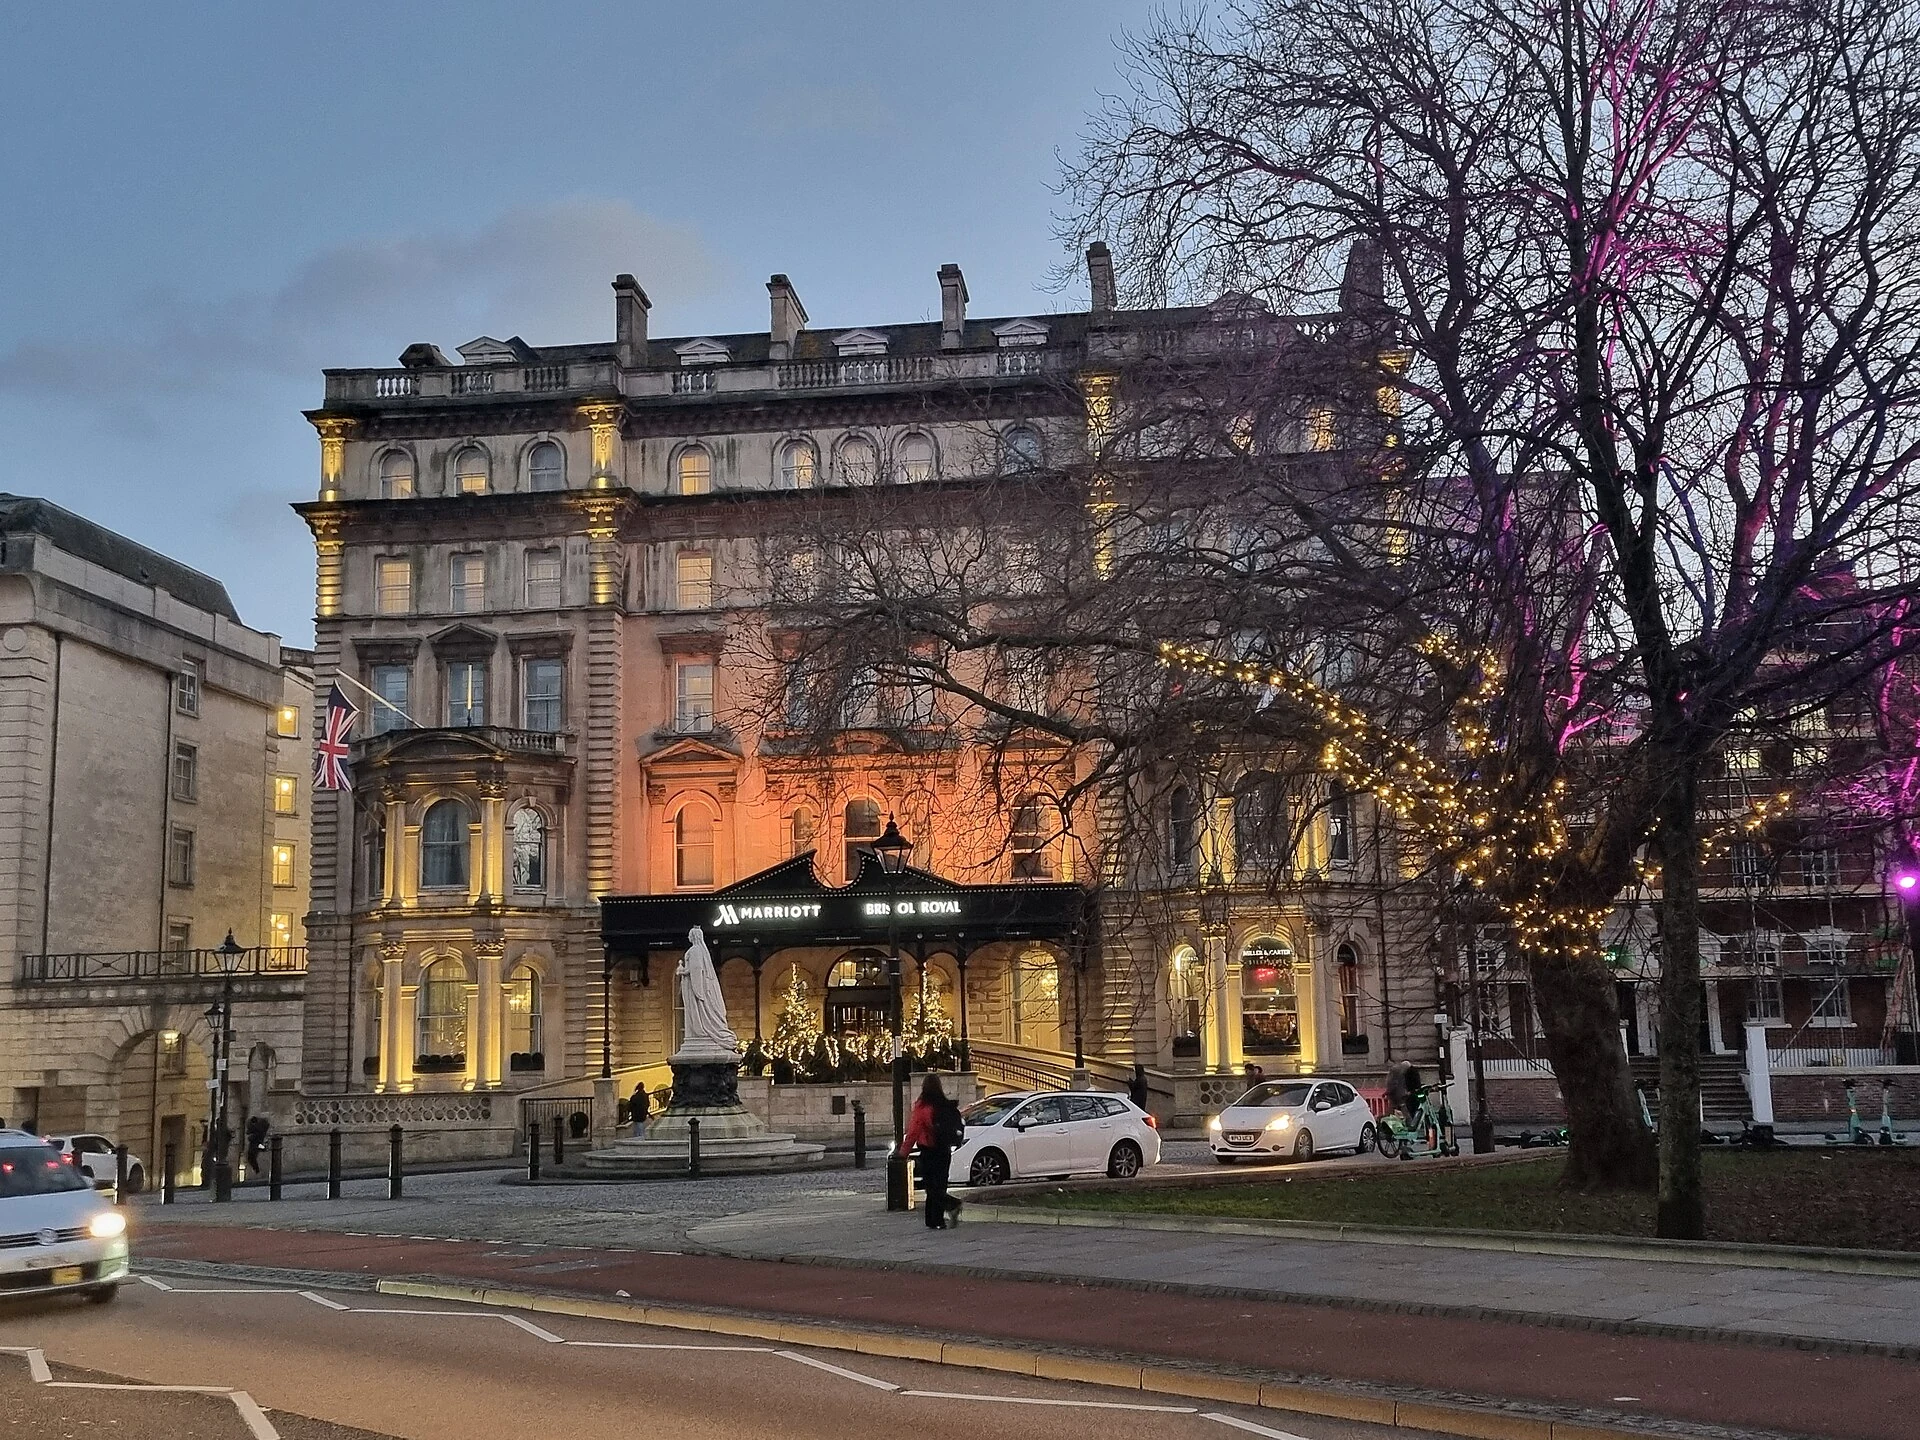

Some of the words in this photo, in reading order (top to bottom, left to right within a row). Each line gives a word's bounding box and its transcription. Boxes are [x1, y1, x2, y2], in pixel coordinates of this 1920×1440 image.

[740, 904, 822, 920] MARRIOTT
[865, 902, 916, 915] BRISOL
[920, 901, 962, 914] ROYAL
